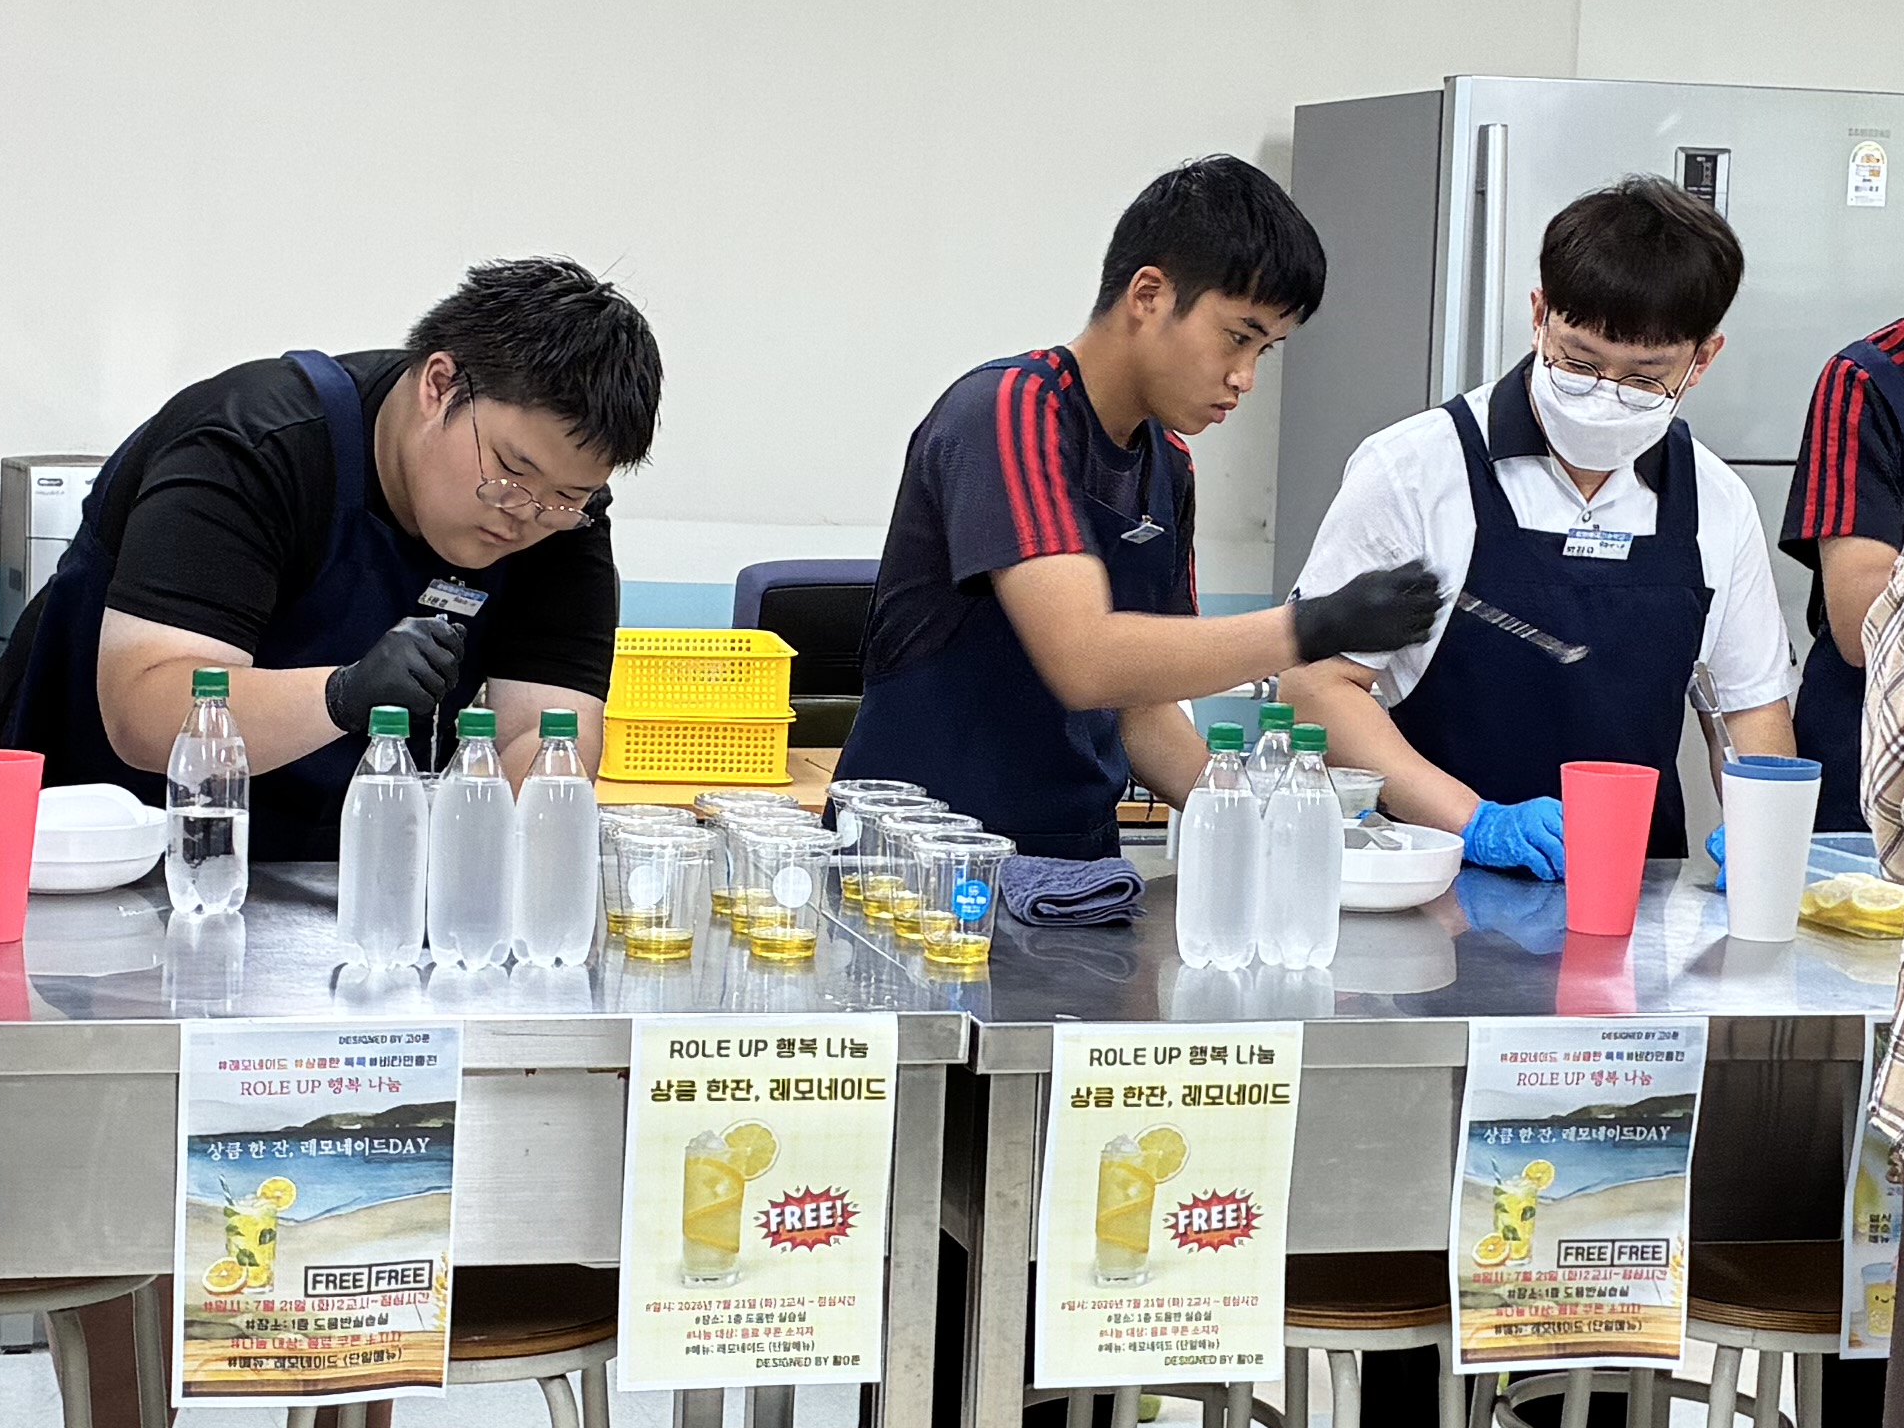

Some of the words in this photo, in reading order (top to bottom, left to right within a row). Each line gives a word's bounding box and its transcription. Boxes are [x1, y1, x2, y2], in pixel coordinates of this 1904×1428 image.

[669, 1039, 731, 1059] ROLE
[738, 1039, 768, 1058] UP
[775, 1037, 818, 1059] 행복
[826, 1037, 869, 1059] 나눔
[1089, 1047, 1147, 1067] ROLE
[1153, 1046, 1181, 1065] UP
[1189, 1045, 1228, 1066] 행복
[1236, 1044, 1275, 1065] 나눔
[240, 1081, 291, 1096] ROLE
[296, 1080, 321, 1094] UP
[328, 1077, 362, 1095] 행복
[368, 1076, 402, 1093] 나눔
[1517, 1072, 1560, 1086] ROLE
[1564, 1072, 1585, 1085] UP
[1624, 1069, 1653, 1086] 나눔
[650, 1079, 698, 1103] 상큼
[706, 1078, 761, 1103] 한잔,
[768, 1077, 887, 1101] 레모네이드
[1070, 1086, 1115, 1109] 상큼
[1123, 1085, 1173, 1109] 한잔,
[1181, 1083, 1291, 1107] 레모네이드
[1483, 1127, 1514, 1144] 상큼
[207, 1140, 243, 1161] 상큼
[248, 1140, 266, 1159] 한
[300, 1136, 430, 1157] 레모네이드DAY
[768, 1198, 845, 1234] FREE!
[1176, 1202, 1250, 1234] FREE!
[1563, 1246, 1608, 1262] FREE
[1617, 1245, 1663, 1261] FREE
[311, 1272, 365, 1291] FREE
[374, 1267, 425, 1287] FREE
[716, 1300, 731, 1310] 7월
[734, 1299, 756, 1310] 21일
[780, 1297, 805, 1308] 2교시
[716, 1342, 765, 1354] 레모네이드
[756, 1358, 812, 1368] DESIGNED
[815, 1356, 830, 1366] BY
